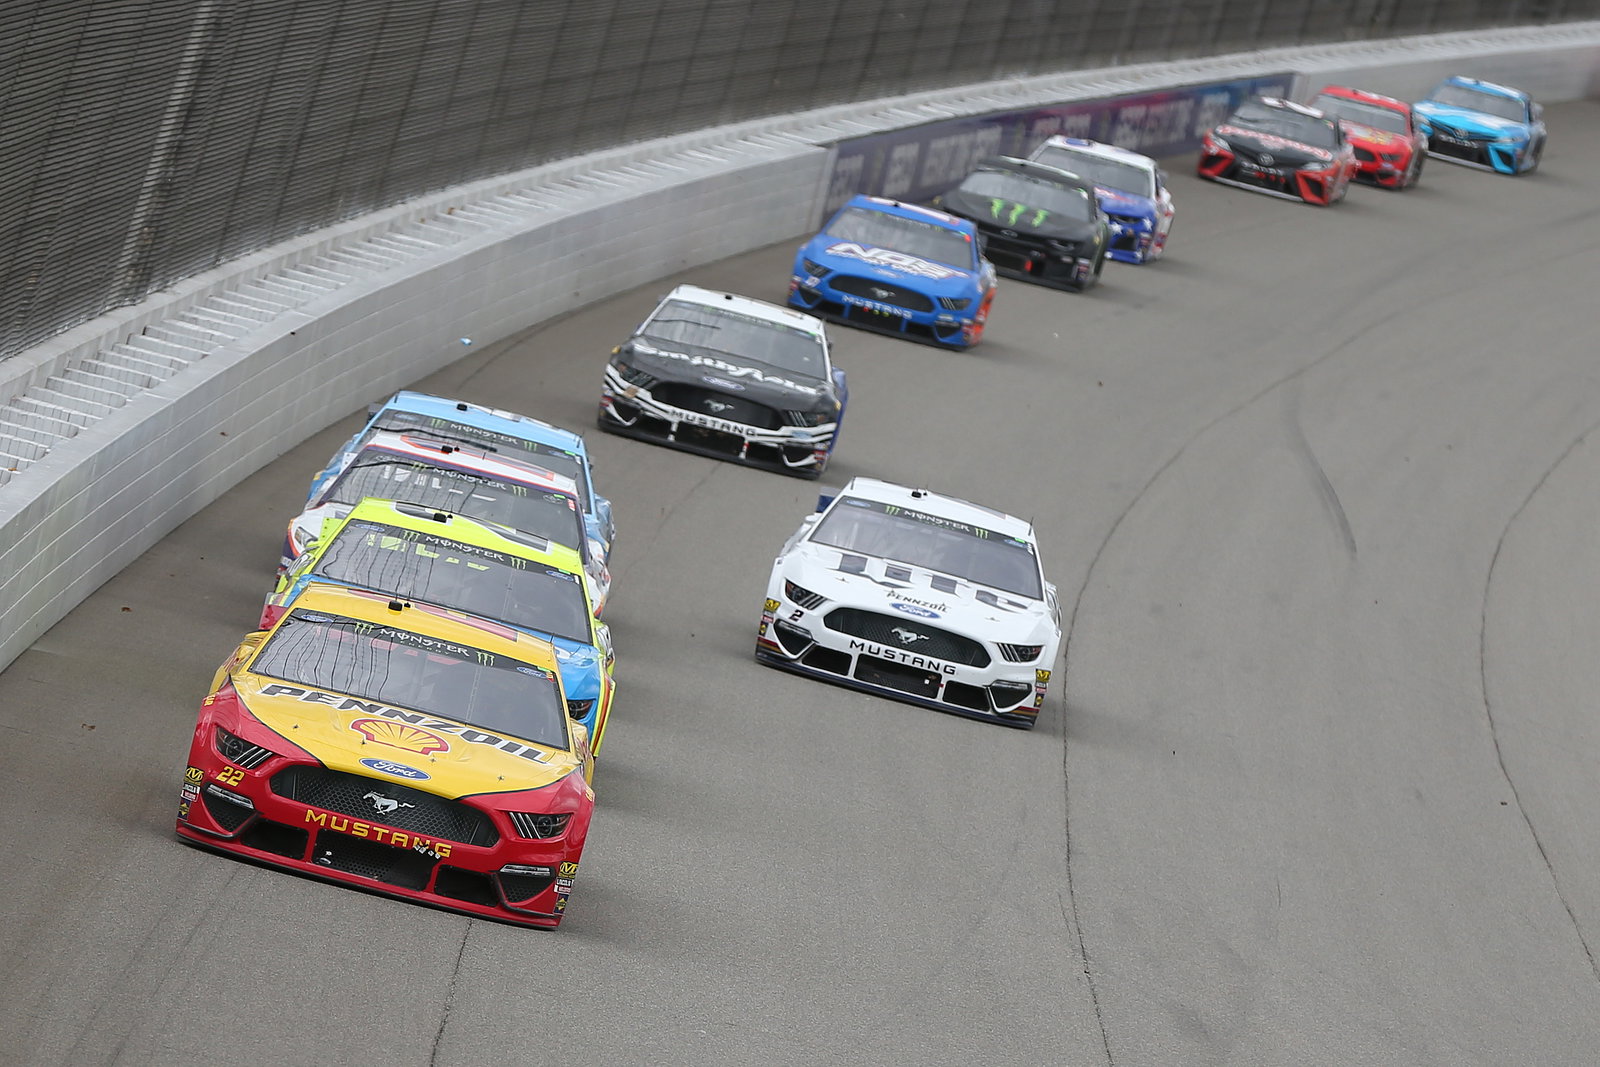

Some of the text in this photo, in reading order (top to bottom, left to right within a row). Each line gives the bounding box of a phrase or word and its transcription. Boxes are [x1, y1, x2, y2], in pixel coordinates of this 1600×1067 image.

[450, 423, 518, 445] MONSTER
[669, 408, 757, 437] MUSTANG
[433, 467, 506, 490] MONSTER
[904, 509, 971, 532] MONSTER
[425, 535, 505, 562] MONSTER
[886, 591, 949, 613] PENNZOIL
[789, 609, 805, 622] 2
[380, 628, 470, 657] MONSTER
[849, 639, 957, 675] MUSTANG
[260, 684, 550, 764] PENNZOIL
[216, 765, 245, 787] 22
[305, 809, 452, 858] MUSTANG
